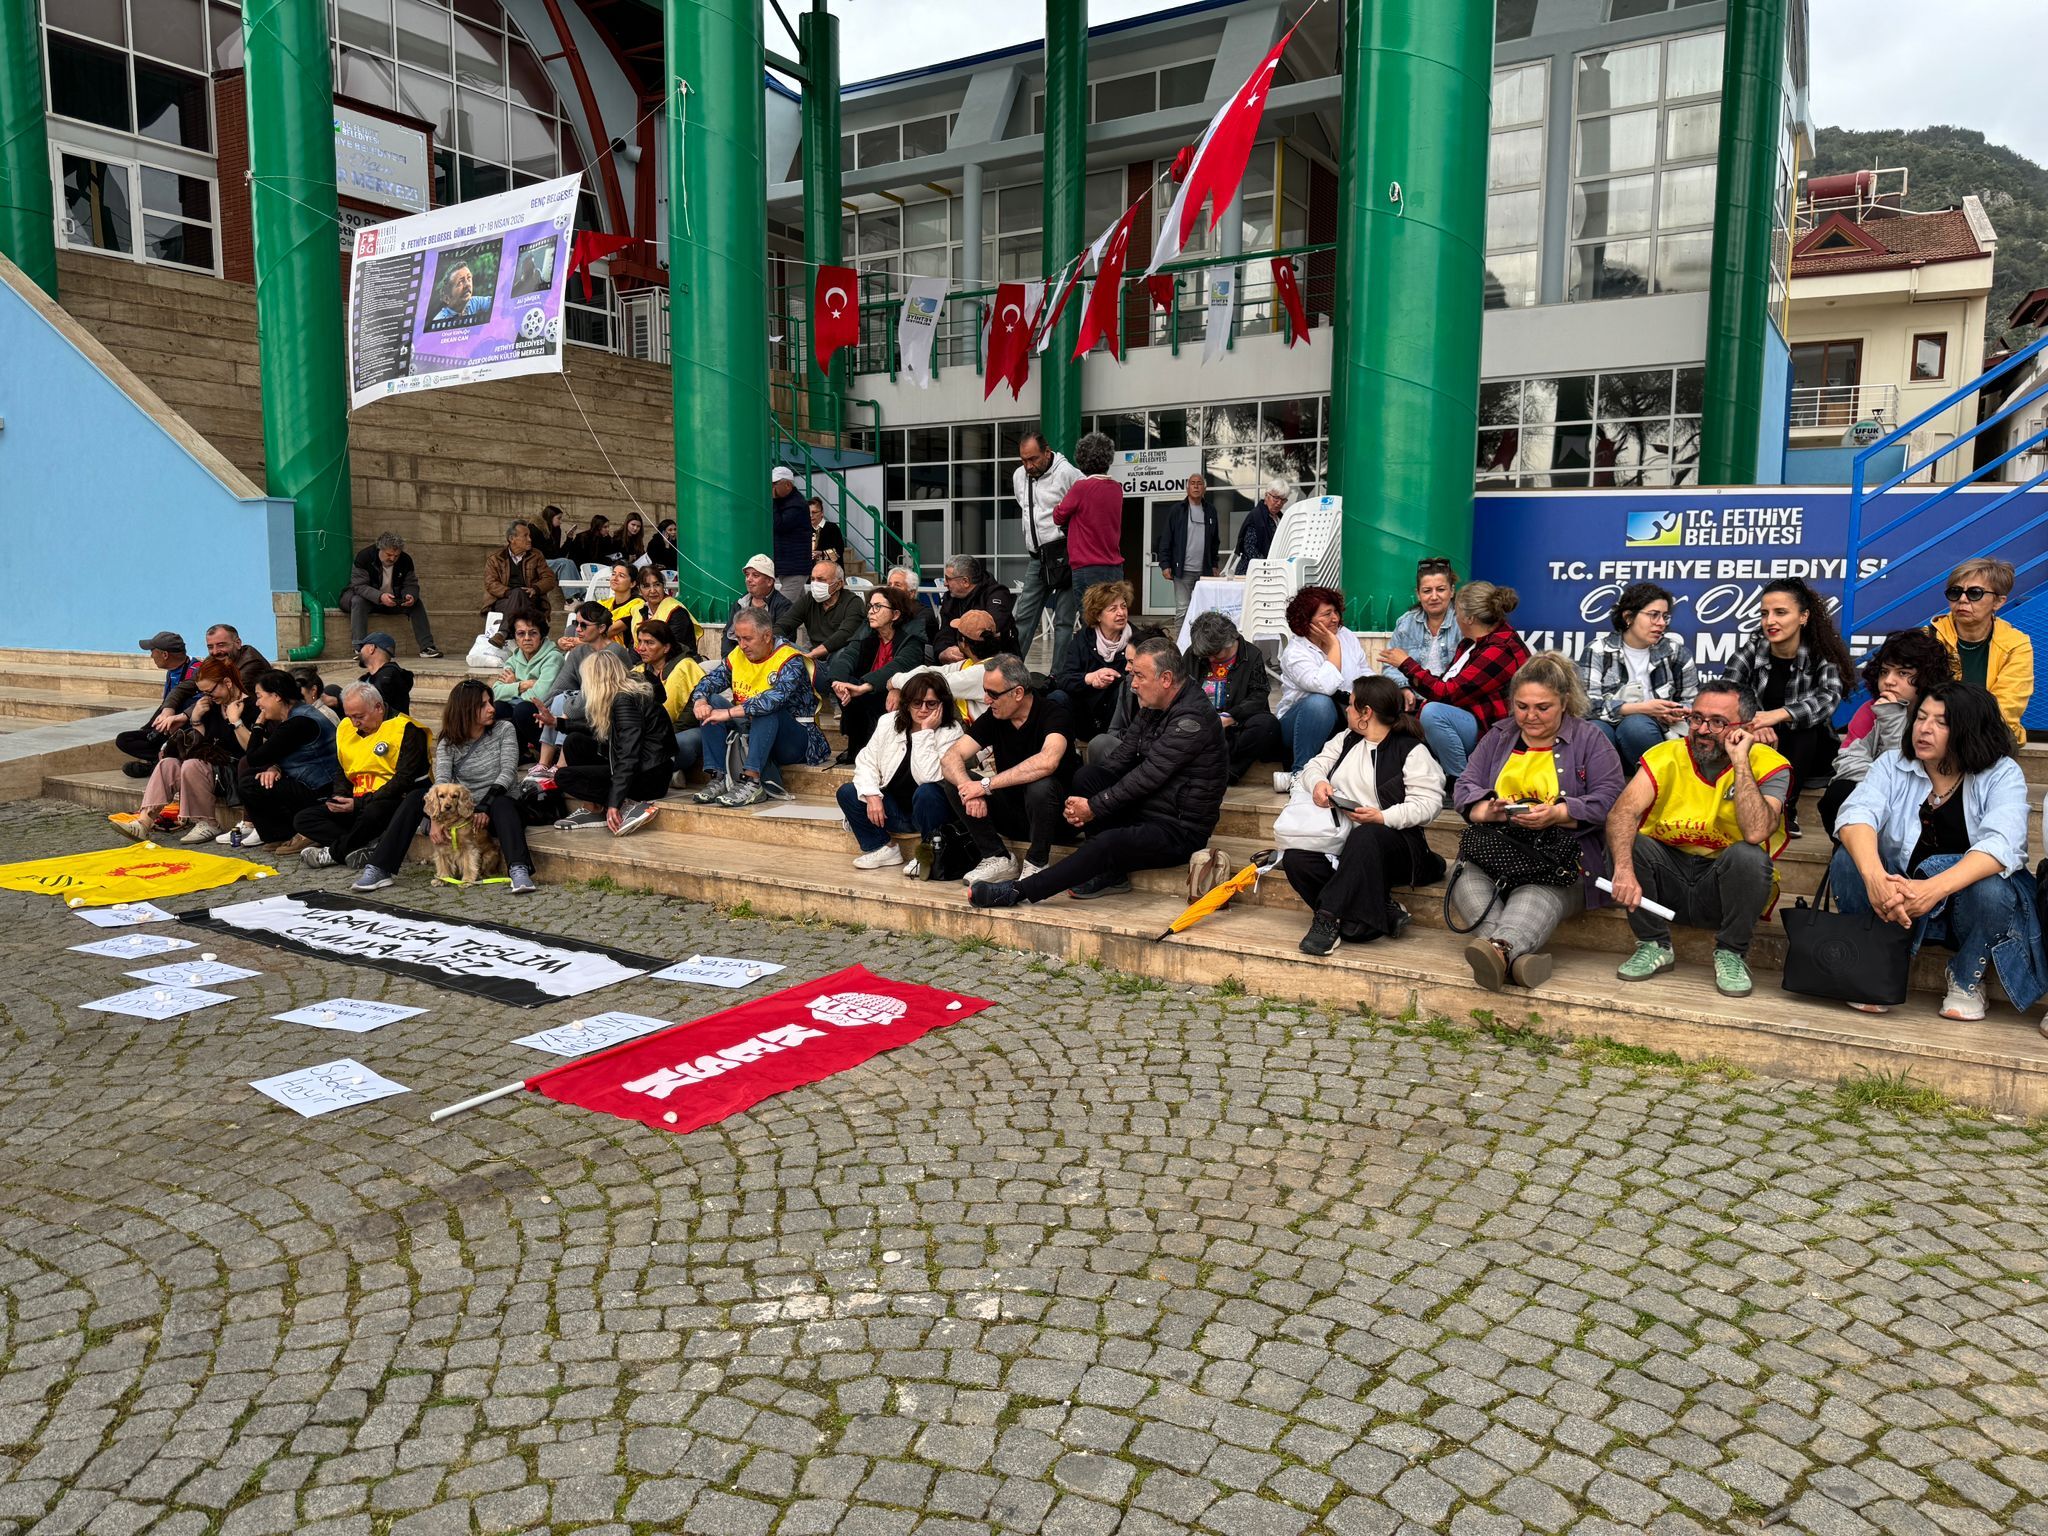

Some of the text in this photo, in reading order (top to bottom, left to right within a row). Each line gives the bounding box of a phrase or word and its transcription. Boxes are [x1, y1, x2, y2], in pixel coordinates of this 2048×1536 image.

[530, 188, 575, 209] GENÇ BELGESEL
[407, 236, 428, 250] FETHİYE
[428, 231, 453, 246] BELGESEL
[493, 216, 510, 230] NİSAN
[499, 350, 520, 361] KÜLTÜR
[520, 346, 545, 358] MERKEZİ
[1855, 427, 1879, 435] UFUK
[1686, 506, 1804, 528] T.C. FETHİYE
[1684, 526, 1802, 547] BELEDİYESİ
[1548, 561, 1594, 580] T.C.
[1599, 559, 1711, 580] FETHİYE
[450, 938, 572, 974] TESLİM
[803, 994, 906, 1025] KESK
[620, 1023, 829, 1100] KESK
